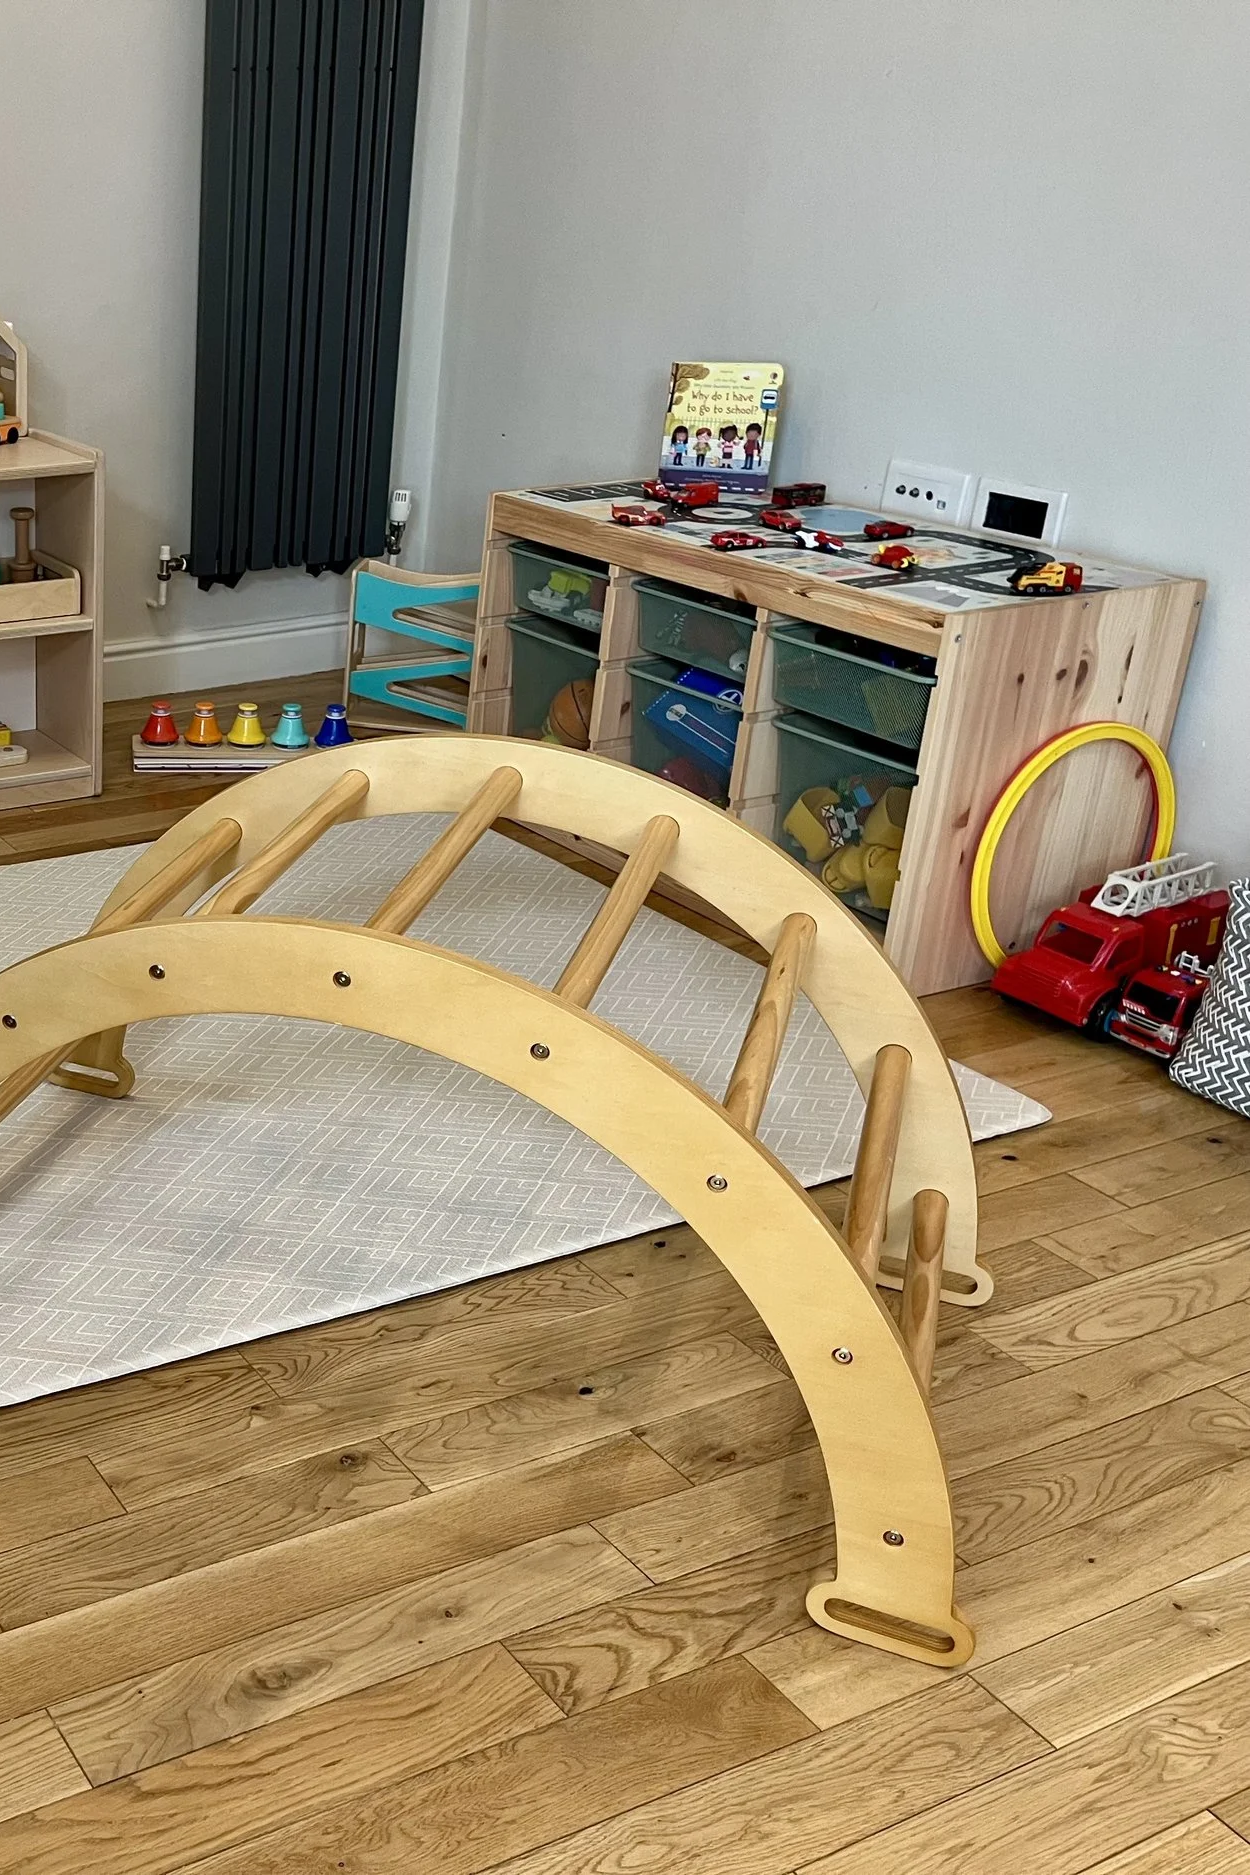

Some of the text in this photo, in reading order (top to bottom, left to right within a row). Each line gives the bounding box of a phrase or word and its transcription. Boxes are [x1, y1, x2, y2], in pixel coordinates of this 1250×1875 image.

[692, 390, 754, 405] Why do I have
[687, 402, 759, 416] to go to school?
